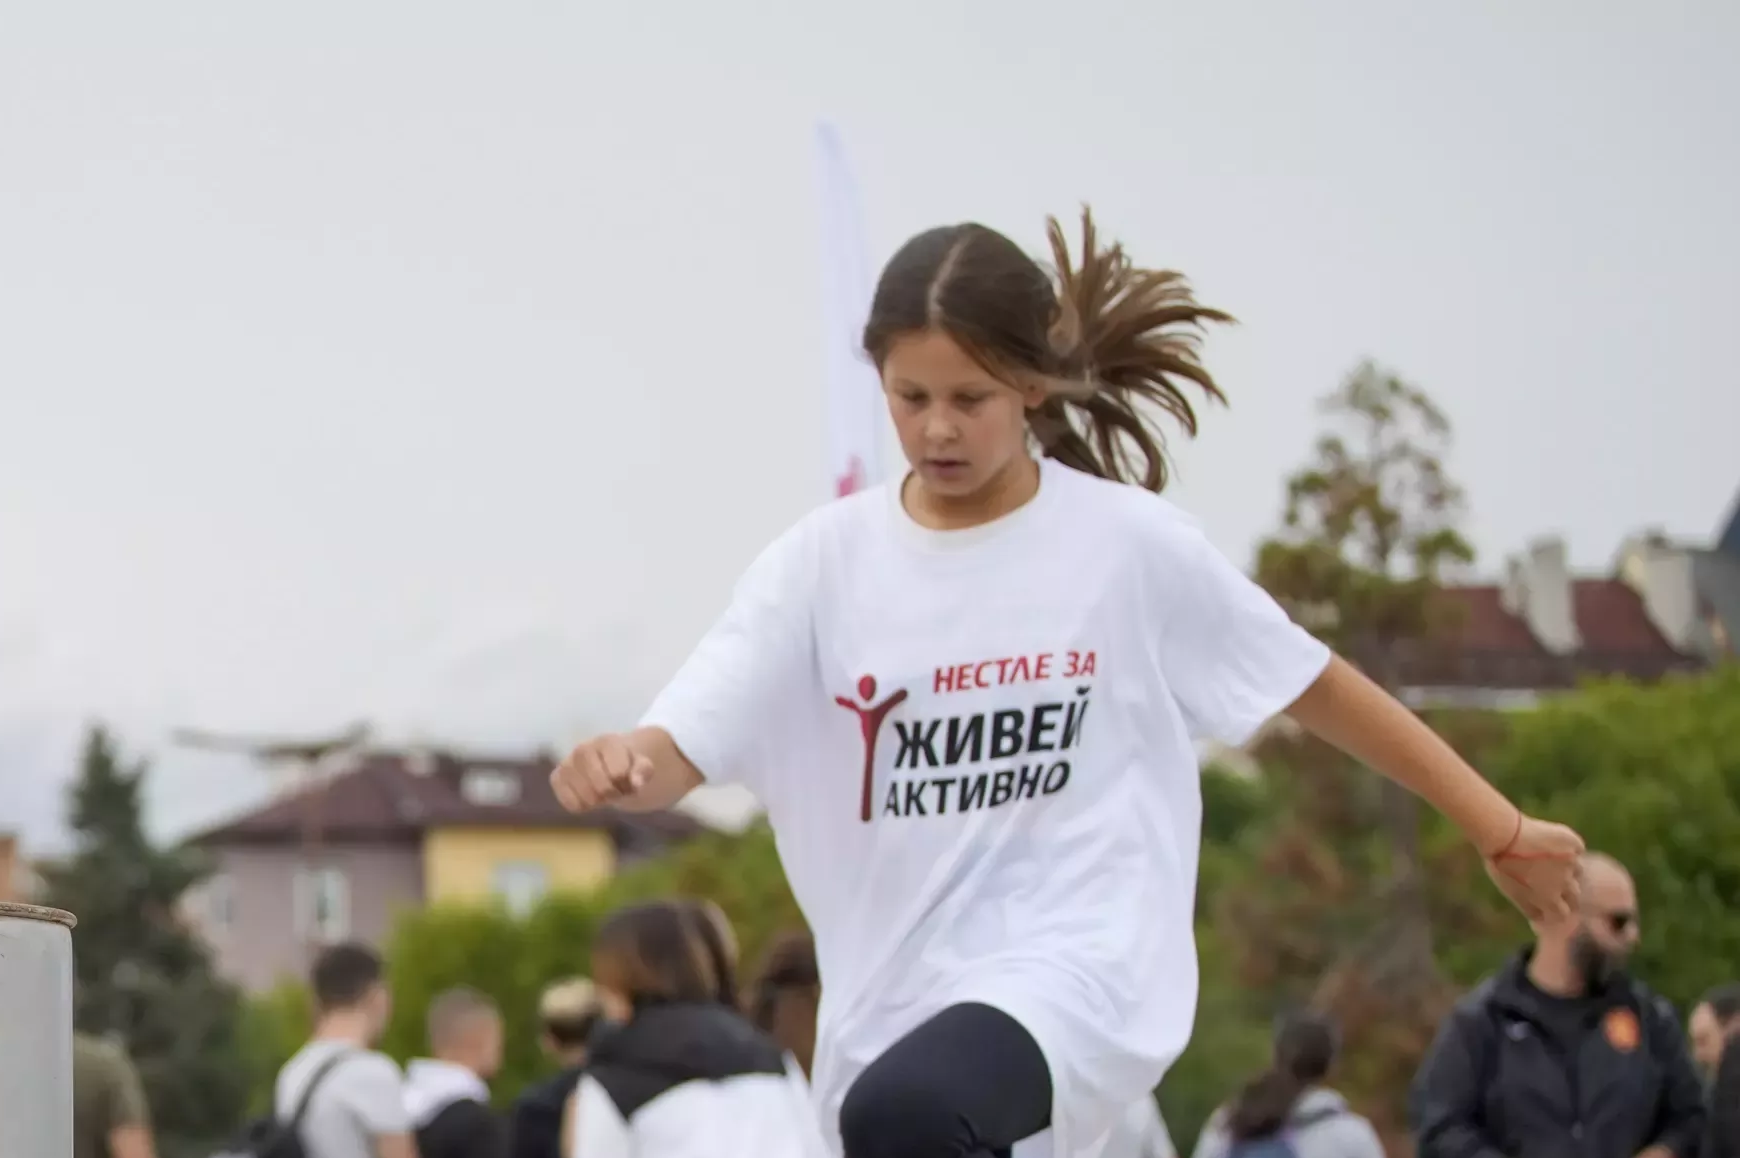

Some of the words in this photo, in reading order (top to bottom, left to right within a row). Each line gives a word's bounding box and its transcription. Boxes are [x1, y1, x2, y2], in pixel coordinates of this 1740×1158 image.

[932, 653, 1054, 695] НЕСТЛЕ
[1062, 650, 1097, 678] ЗА
[892, 684, 1092, 770] ЖИВЕЙ
[882, 760, 1071, 817] АКТИВНО
